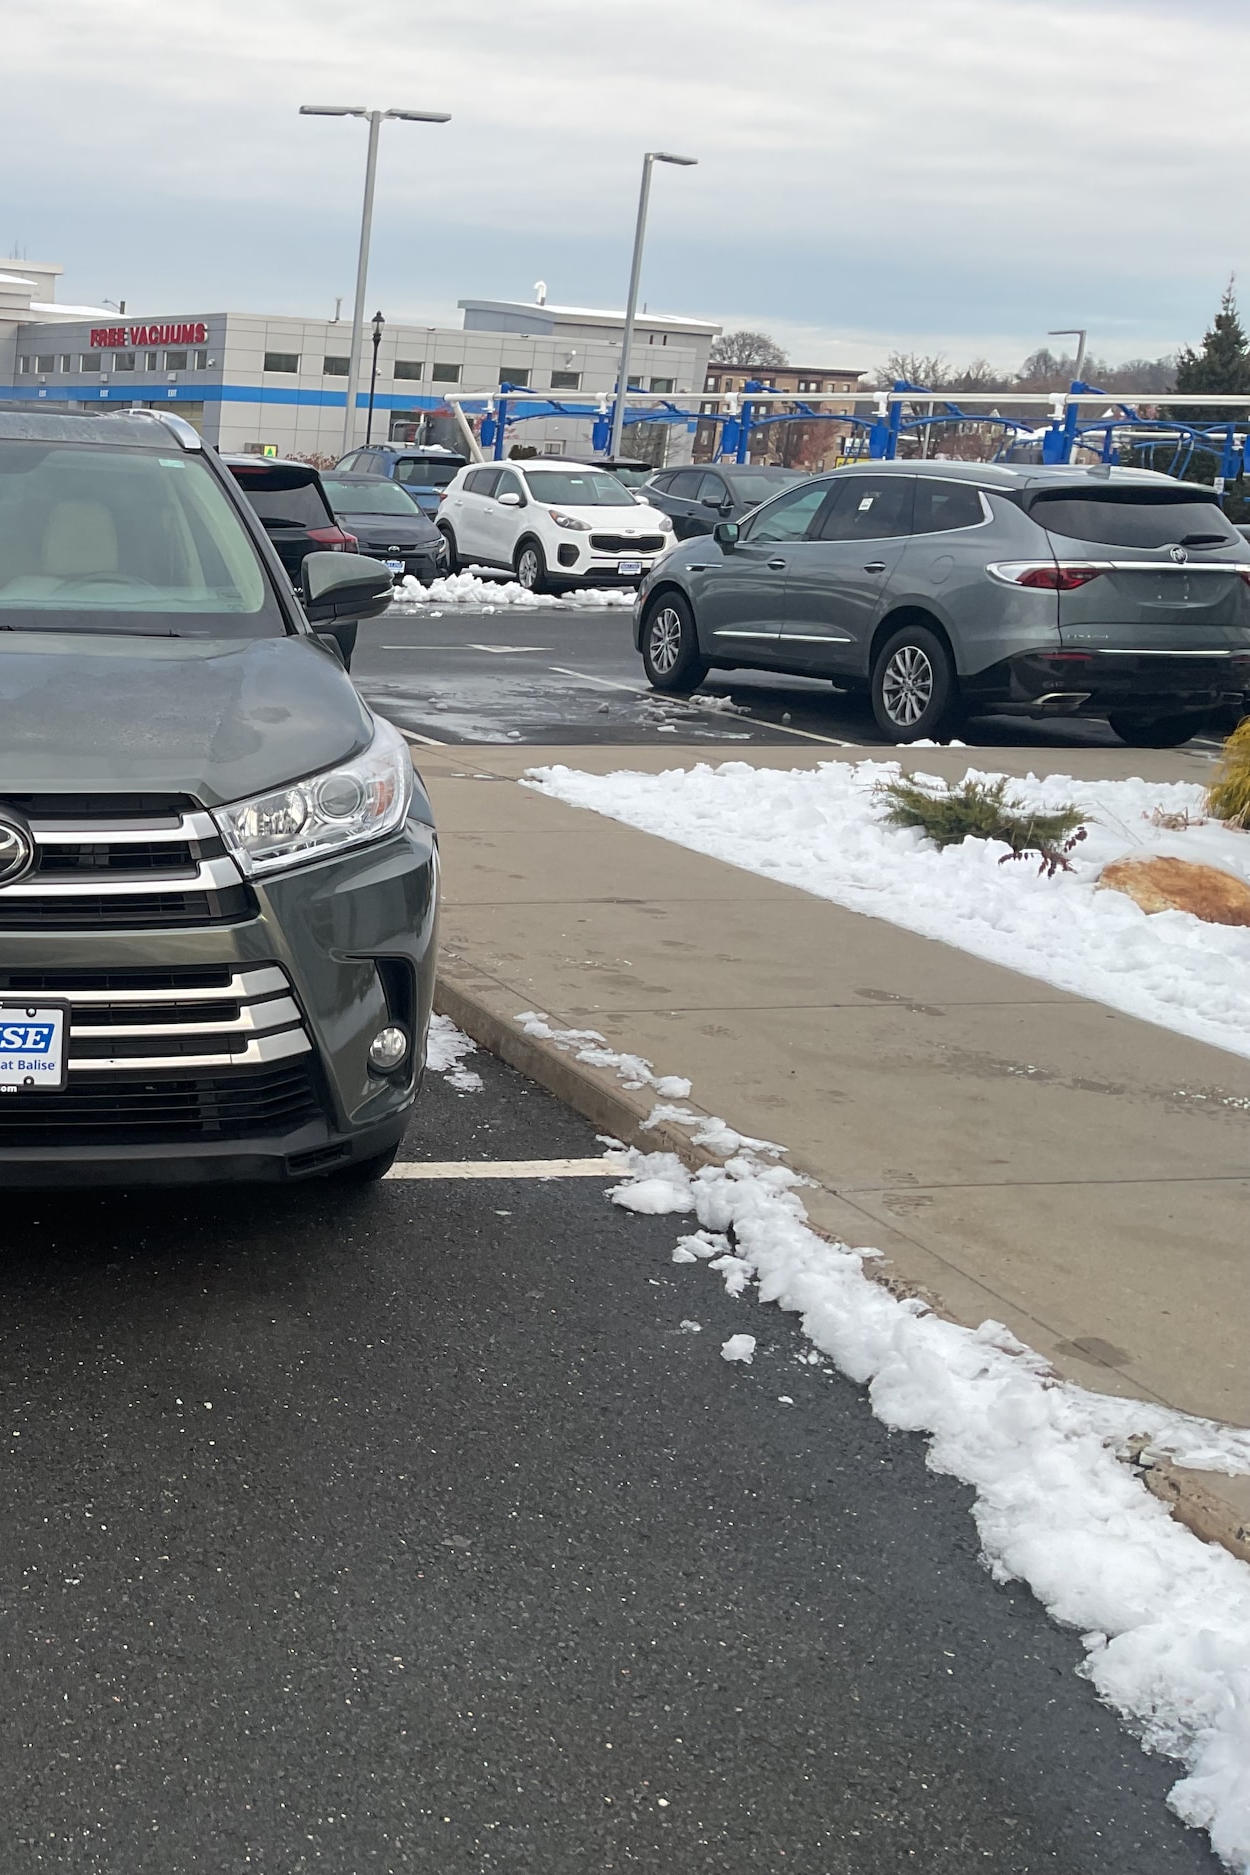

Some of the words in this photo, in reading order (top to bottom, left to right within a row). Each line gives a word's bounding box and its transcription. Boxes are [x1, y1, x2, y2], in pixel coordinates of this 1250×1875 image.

[90, 327, 128, 347] FREE
[130, 323, 208, 345] VACUUMS
[0, 1060, 14, 1071] at
[18, 1060, 55, 1072] Balise
